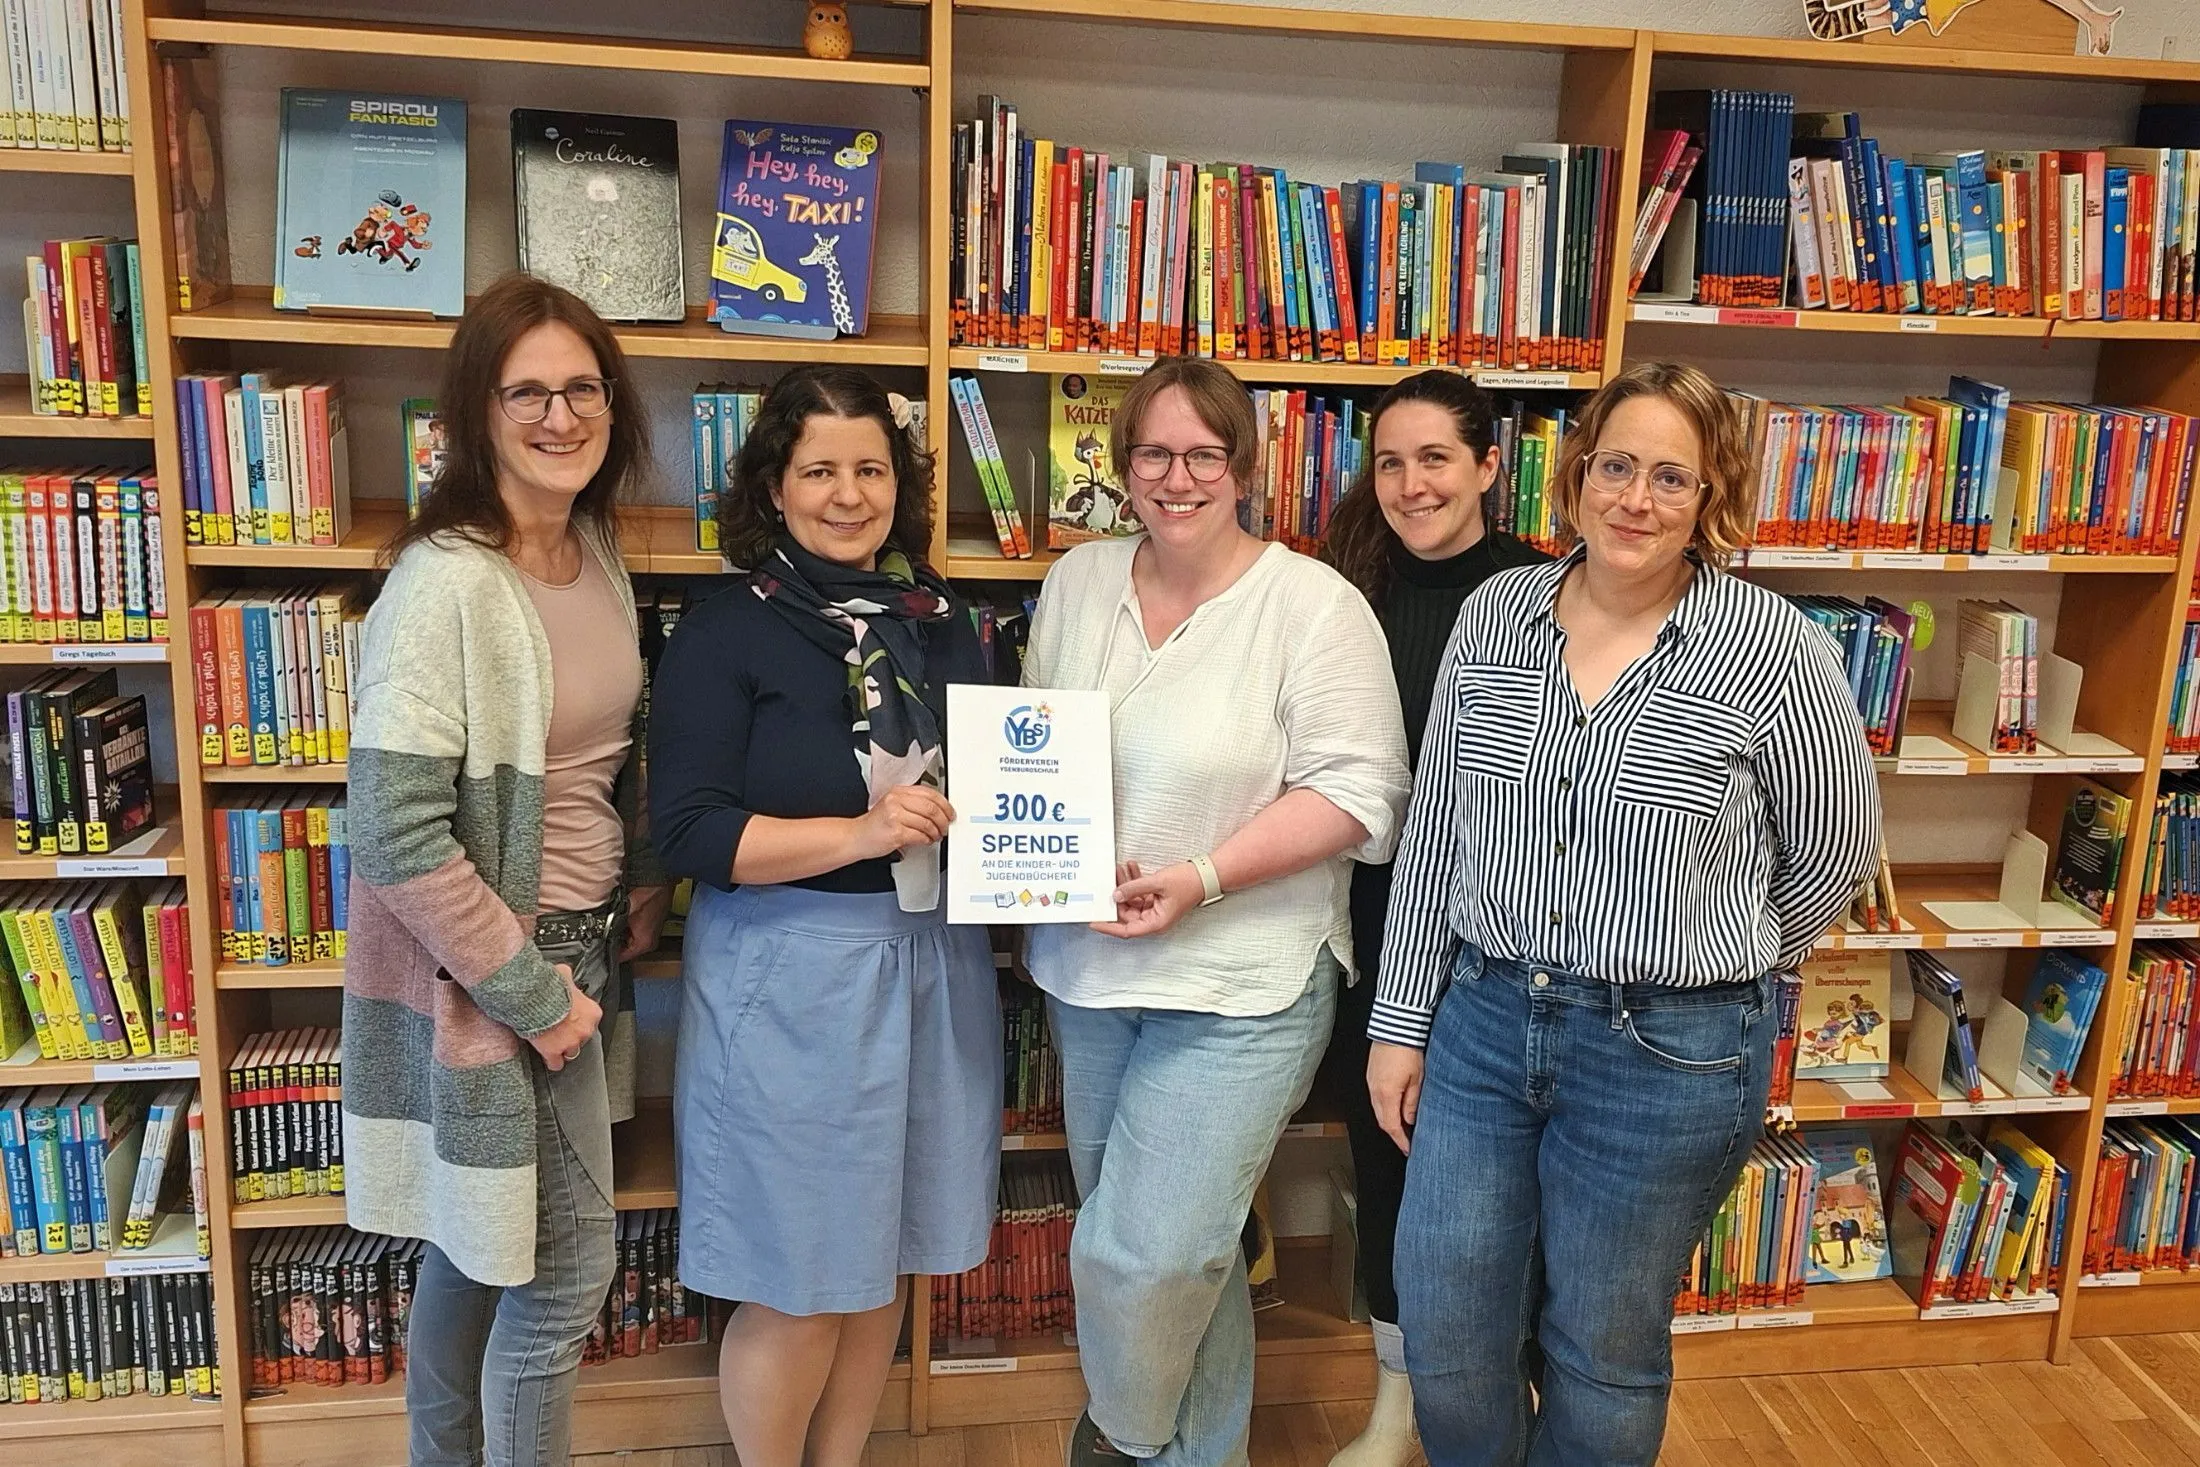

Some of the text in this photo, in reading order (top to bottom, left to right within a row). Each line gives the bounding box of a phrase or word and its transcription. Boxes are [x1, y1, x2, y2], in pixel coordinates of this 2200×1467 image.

[350, 100, 438, 117] SPIROU
[350, 114, 438, 127] FANTASIO
[556, 138, 655, 167] Coraline
[747, 151, 849, 197] Hey, hey,
[731, 182, 865, 225] hey, TAXI!
[1035, 206, 1047, 244] Märchen
[1398, 255, 1408, 280] KLEINE
[1398, 281, 1408, 295] DER
[1537, 378, 1565, 386] Legenden
[1092, 396, 1109, 406] DAS
[264, 417, 278, 482] Der kleine Lord
[1911, 603, 1936, 628] NEU!
[60, 650, 116, 659] Gregs Tagebuch
[204, 651, 219, 720] SCHOOL OF TALENTS
[232, 681, 240, 691] OF
[256, 650, 269, 718] SCHOOL OF TALENTS
[233, 693, 243, 719] SCHOOL
[1006, 716, 1044, 746] YBS
[1000, 756, 1059, 766] FÖRDERVEREIN
[994, 793, 1065, 822] 300 €
[982, 834, 1080, 854] SPENDE
[982, 860, 1080, 869] AN DIE KINDER- UND
[986, 872, 1077, 881] JUGENDBÜCHEREI
[306, 1137, 315, 1152] Party
